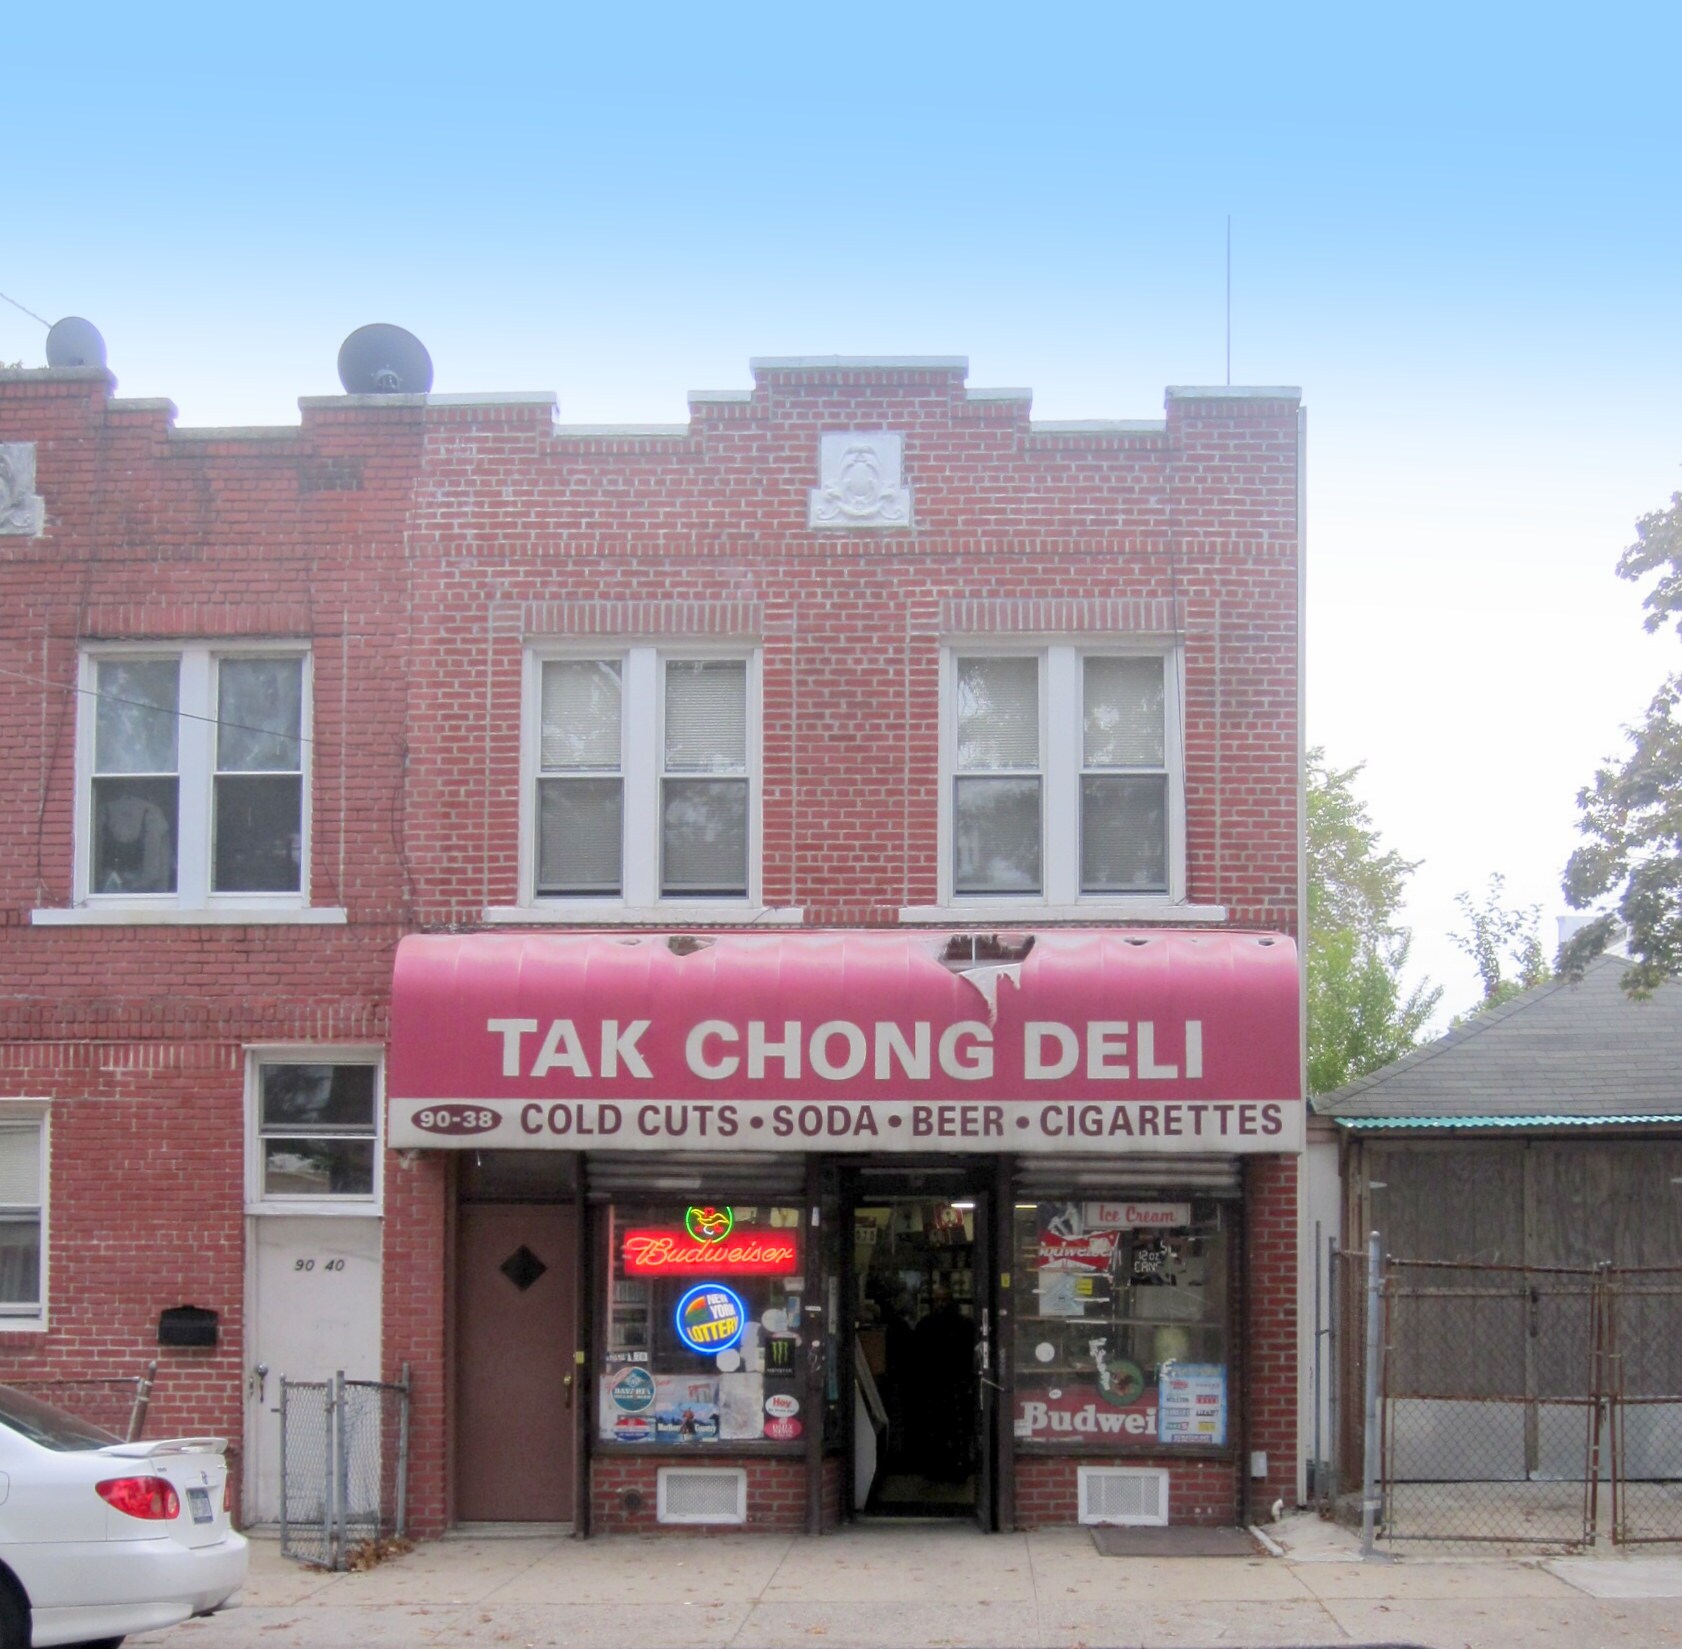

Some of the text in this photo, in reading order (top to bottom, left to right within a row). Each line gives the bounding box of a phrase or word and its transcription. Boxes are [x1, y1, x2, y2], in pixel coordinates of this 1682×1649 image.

[488, 1018, 1203, 1081] TAK CHONG DELI
[419, 1104, 1283, 1137] 90-38 COLD CUTS SODA BEER CIGARETTES
[1099, 1205, 1178, 1223] Ice Cream
[625, 1236, 793, 1266] Budweiser
[294, 1259, 345, 1272] 90 40
[706, 1293, 729, 1305] NEW
[709, 1303, 736, 1320] YORK
[686, 1316, 739, 1343] LOTTERY
